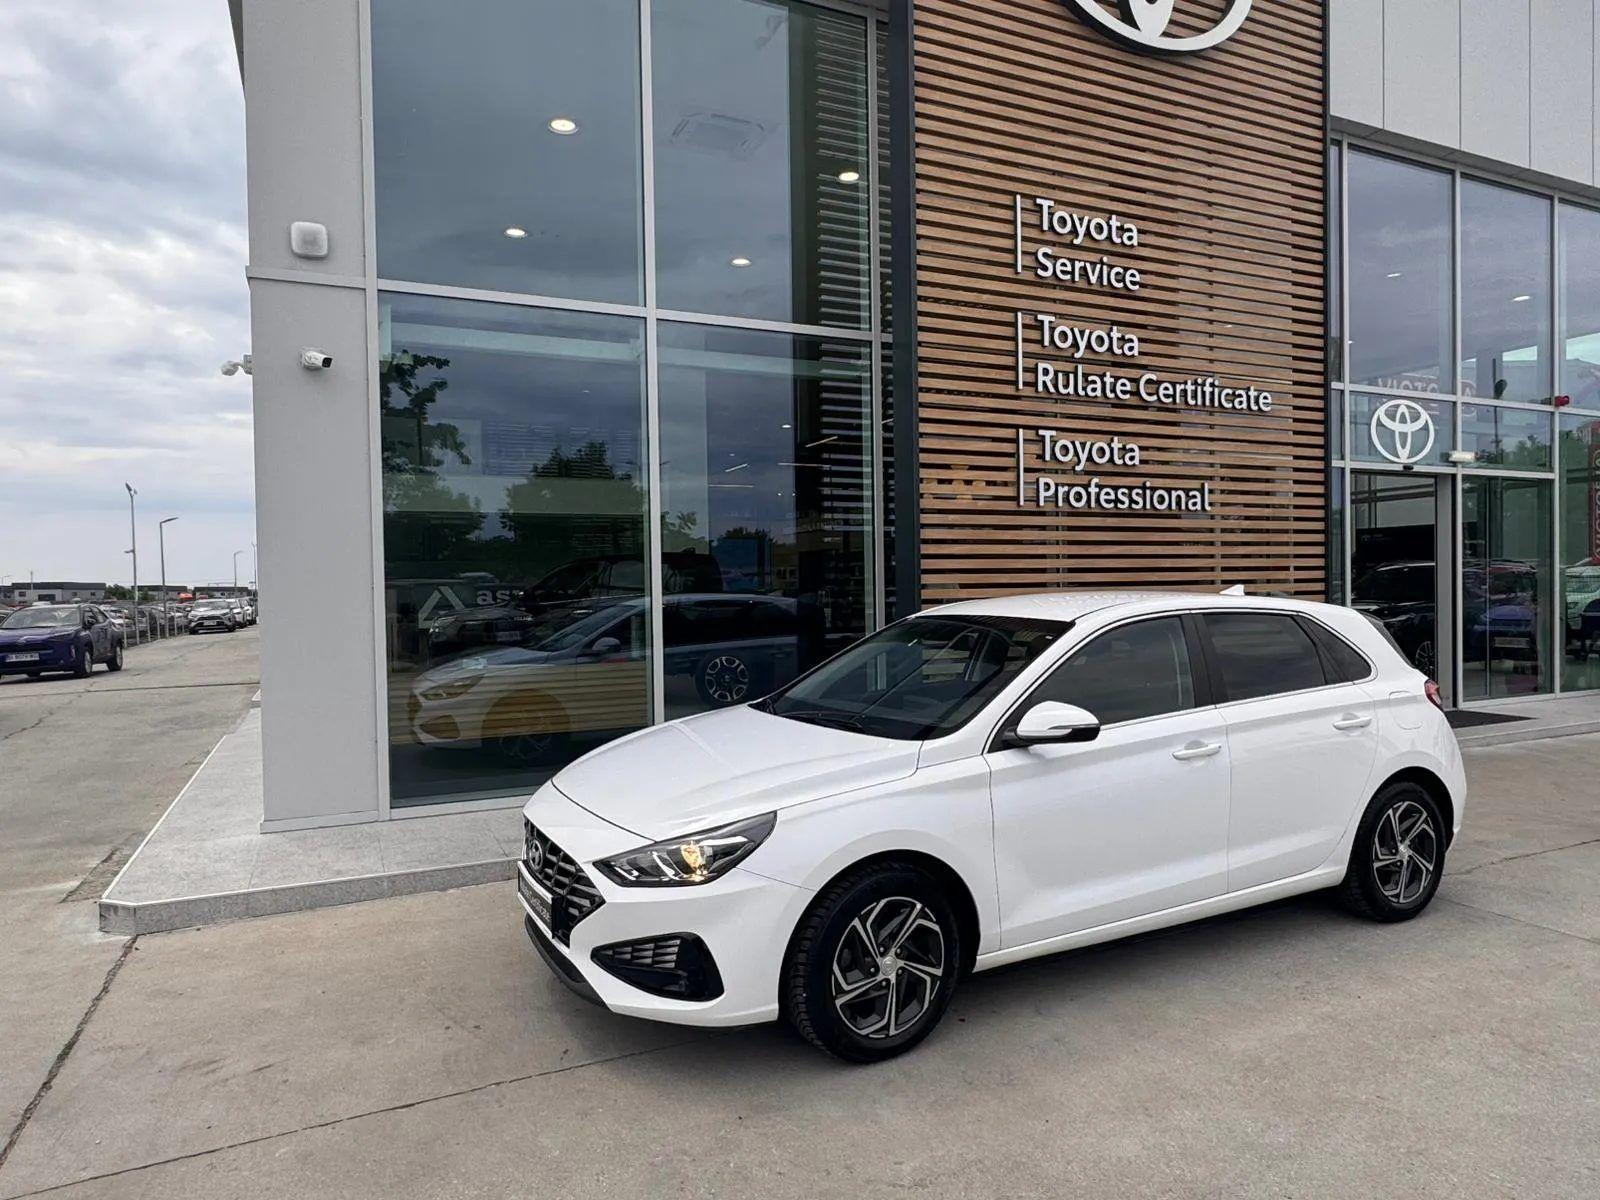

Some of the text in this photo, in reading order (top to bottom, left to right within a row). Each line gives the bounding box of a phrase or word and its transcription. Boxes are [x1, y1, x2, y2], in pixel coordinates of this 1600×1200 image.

[1036, 198, 1138, 246] Toyota
[1037, 247, 1140, 290] Service
[1037, 314, 1139, 355] Toyota
[1037, 362, 1272, 411] Rulate Certificate
[1038, 430, 1140, 471] Toyota
[1038, 477, 1211, 511] Professional
